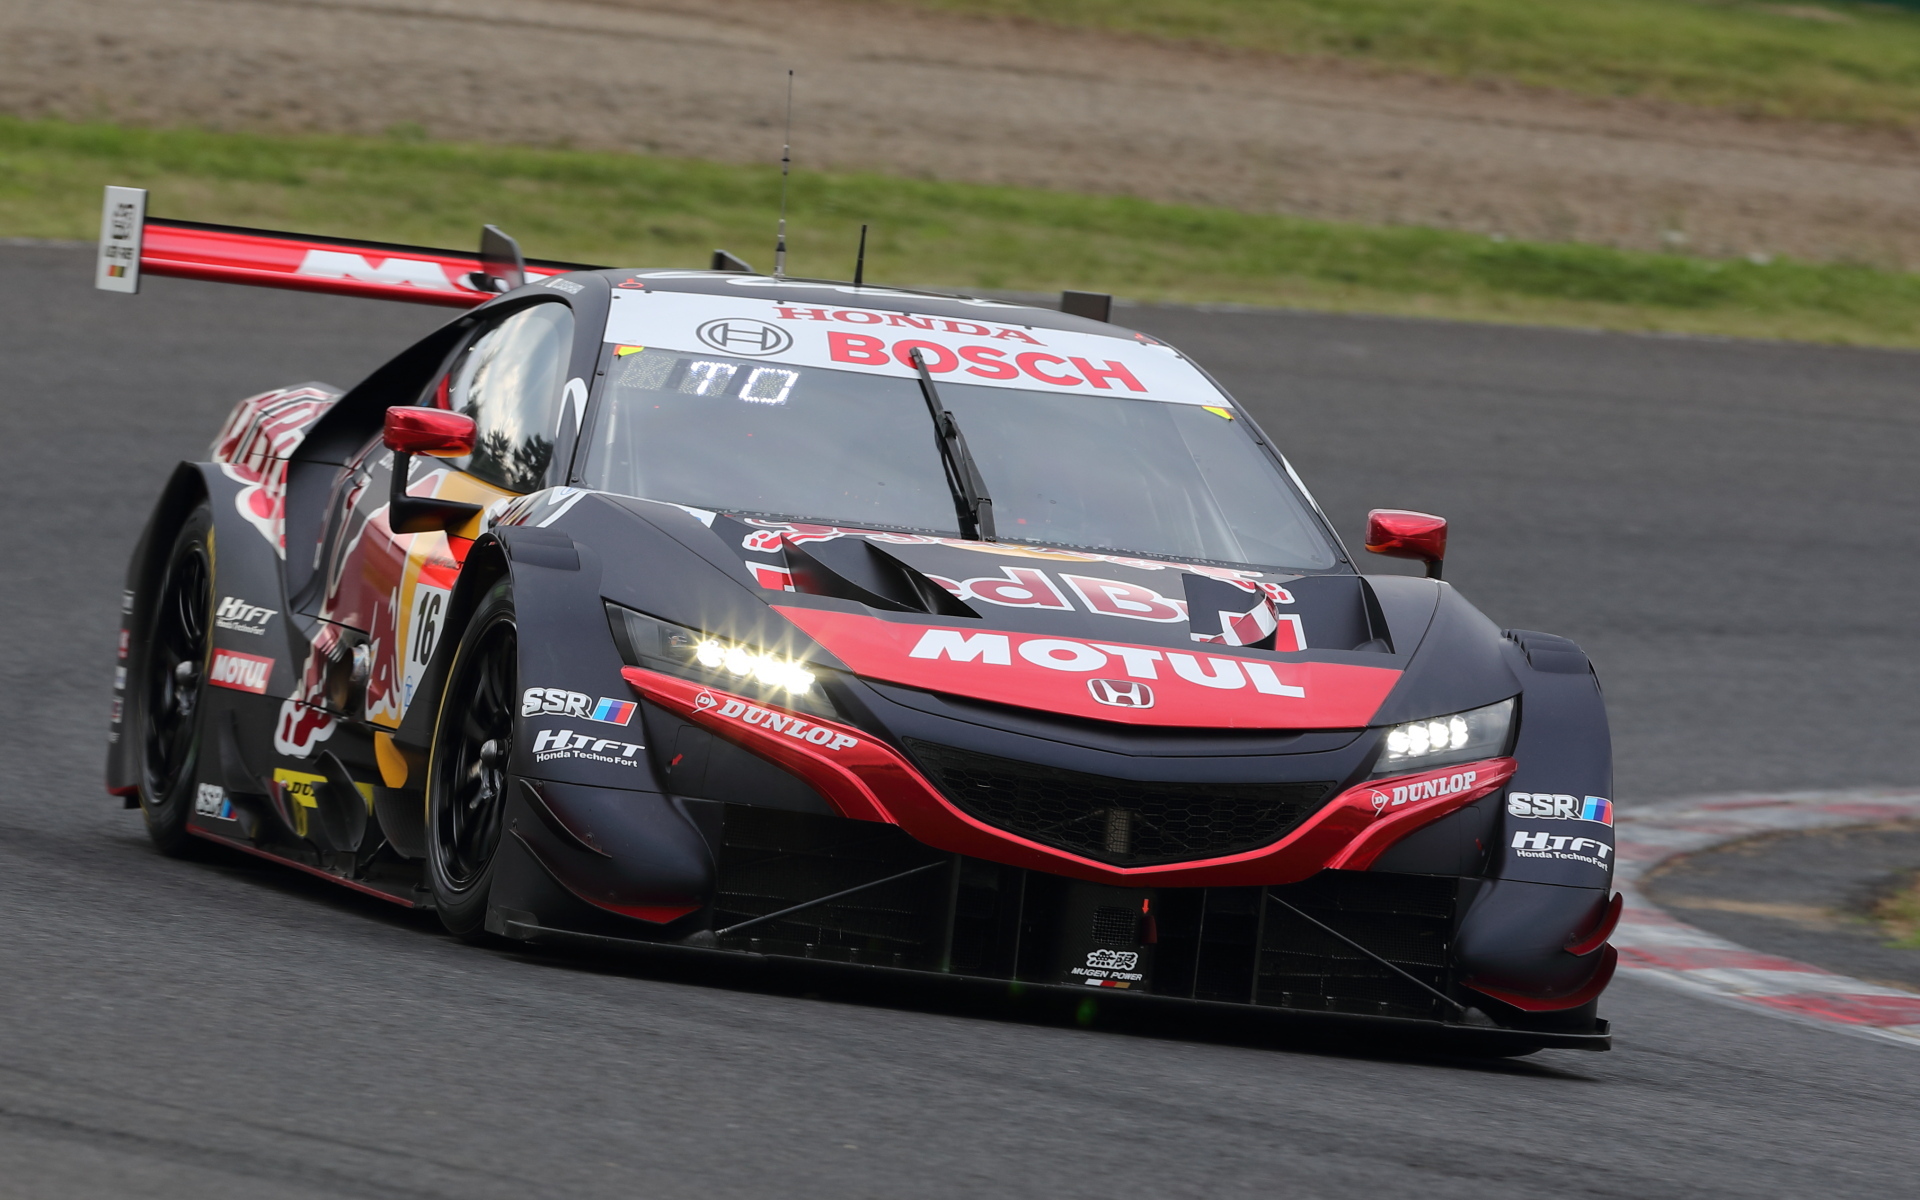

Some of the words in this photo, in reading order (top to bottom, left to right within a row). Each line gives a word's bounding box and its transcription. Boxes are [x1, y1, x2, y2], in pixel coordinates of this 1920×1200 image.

[771, 305, 1048, 347] HONDA
[826, 330, 1149, 393] BOSCH
[215, 596, 279, 625] HTFT
[412, 592, 441, 666] 16
[210, 654, 269, 689] MOTUL
[908, 628, 1306, 699] MOTUL
[522, 687, 592, 718] SSR
[716, 699, 858, 751] DUNLOP
[532, 730, 645, 757] HTFT
[536, 750, 571, 763] Honda
[1391, 771, 1476, 806] DUNLOP
[1508, 792, 1580, 819] SSR
[1511, 831, 1612, 859] HTFT
[1517, 850, 1553, 859] Honda
[1071, 967, 1109, 978] MUGEN
[1110, 971, 1142, 980] POWER
